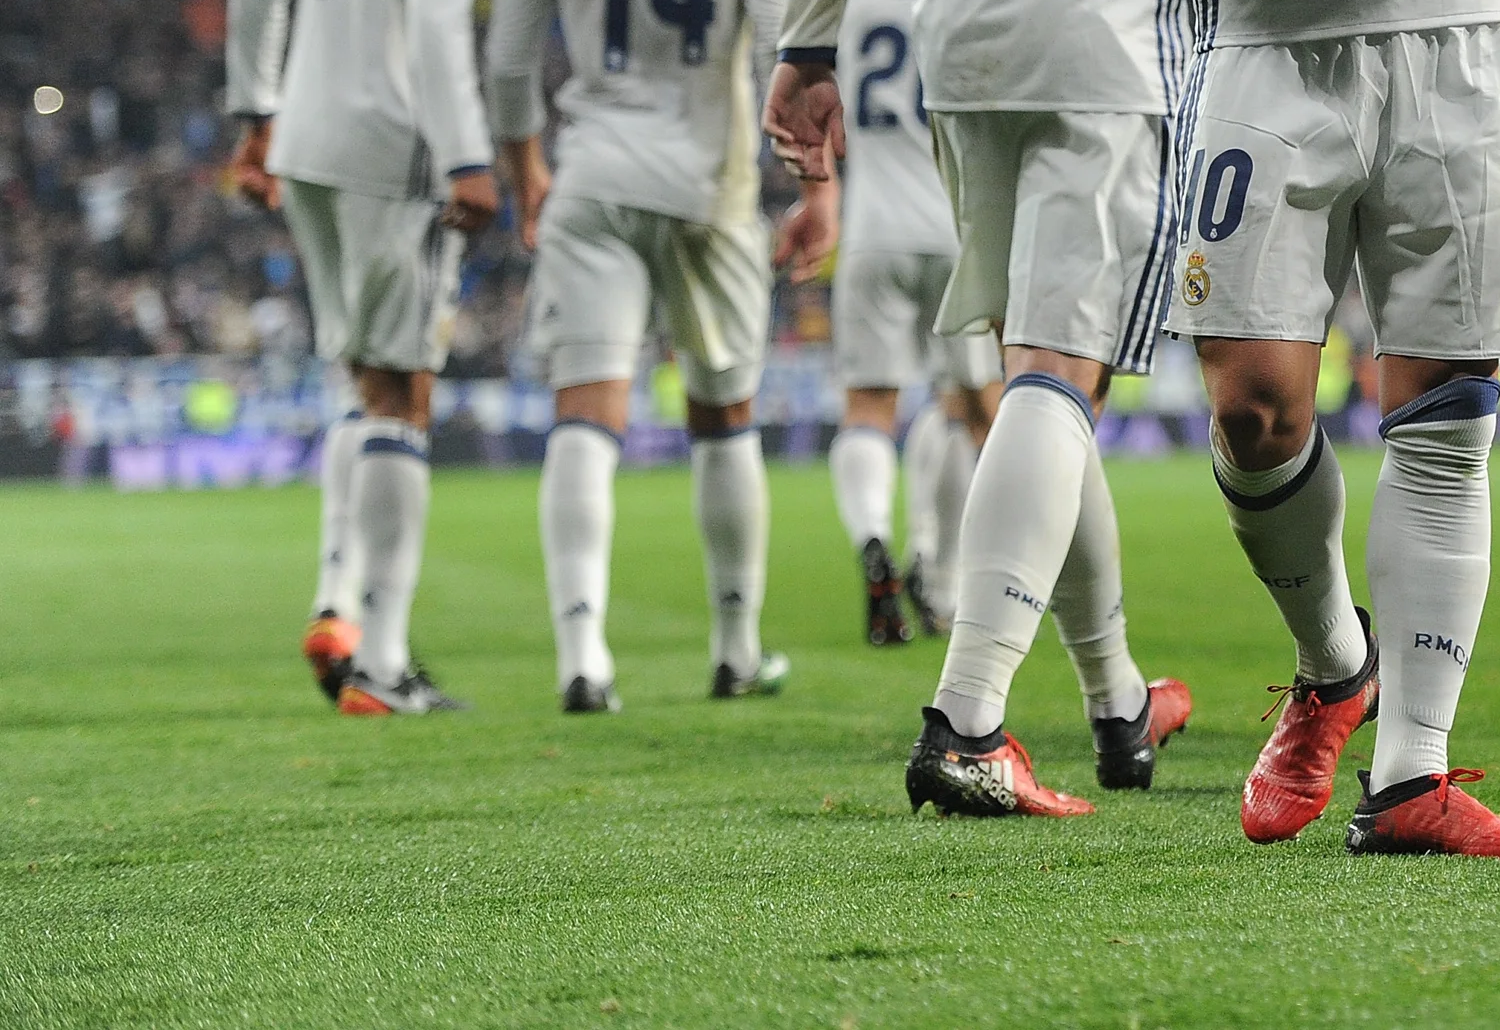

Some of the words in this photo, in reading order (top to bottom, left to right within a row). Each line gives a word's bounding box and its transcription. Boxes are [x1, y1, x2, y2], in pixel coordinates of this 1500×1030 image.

[1180, 148, 1254, 247] 10
[1414, 633, 1468, 673] RMC
[965, 764, 1018, 810] adidas
